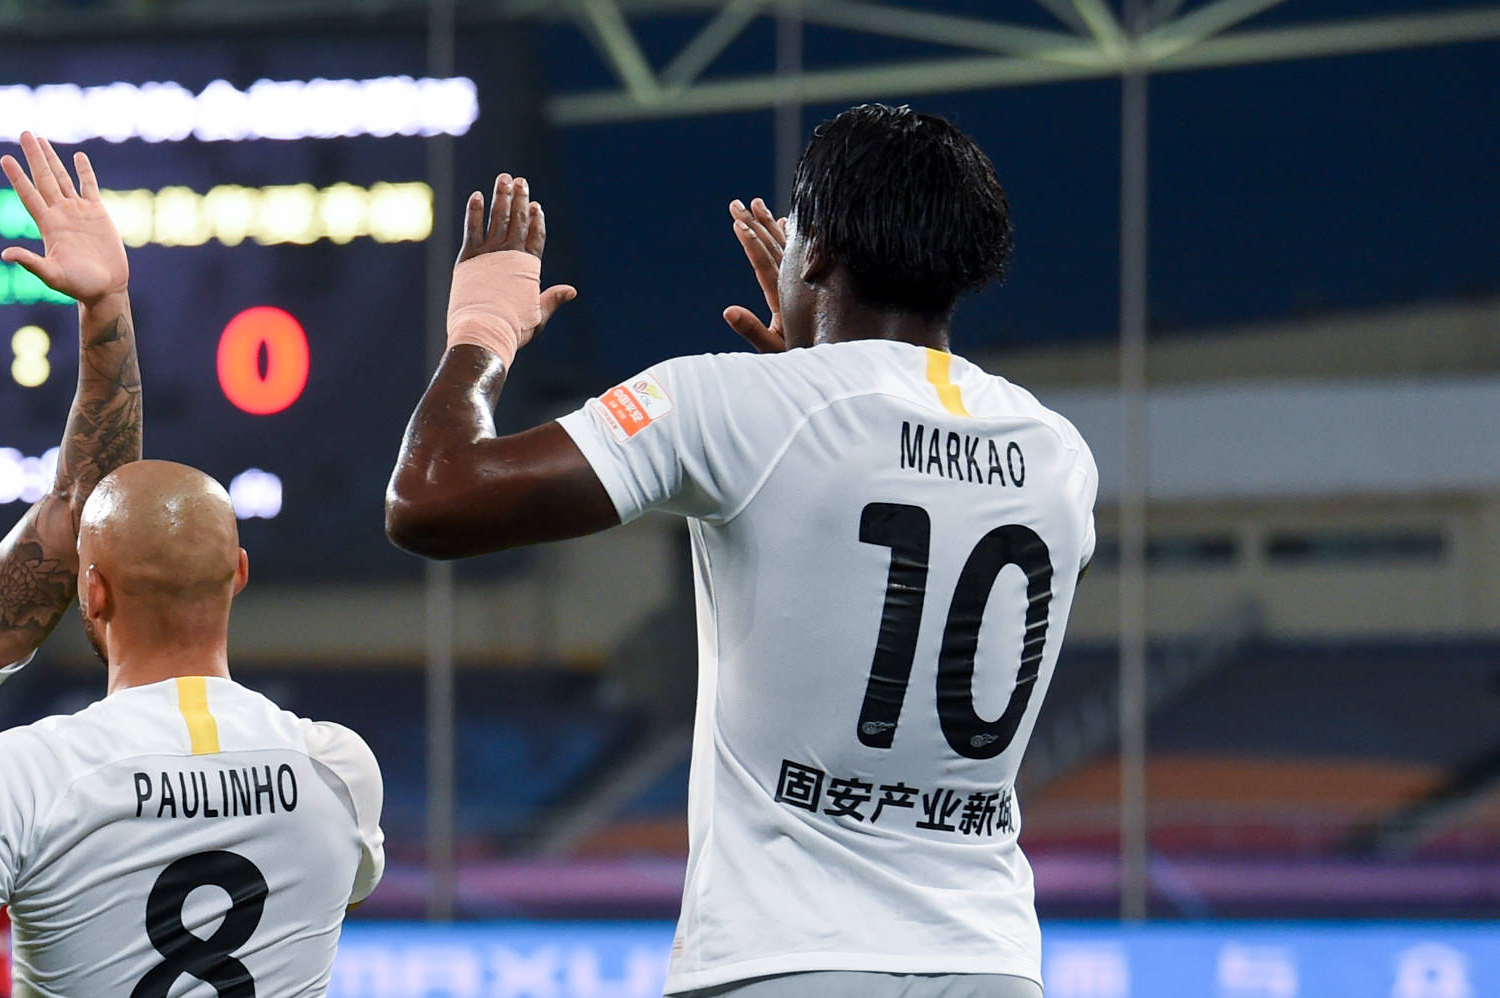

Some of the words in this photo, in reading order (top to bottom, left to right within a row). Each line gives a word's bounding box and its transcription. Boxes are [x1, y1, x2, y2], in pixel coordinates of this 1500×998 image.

[216, 306, 311, 415] 0
[900, 420, 1026, 488] MARKAO
[856, 502, 1053, 760] 10
[133, 763, 298, 819] PAULINHO
